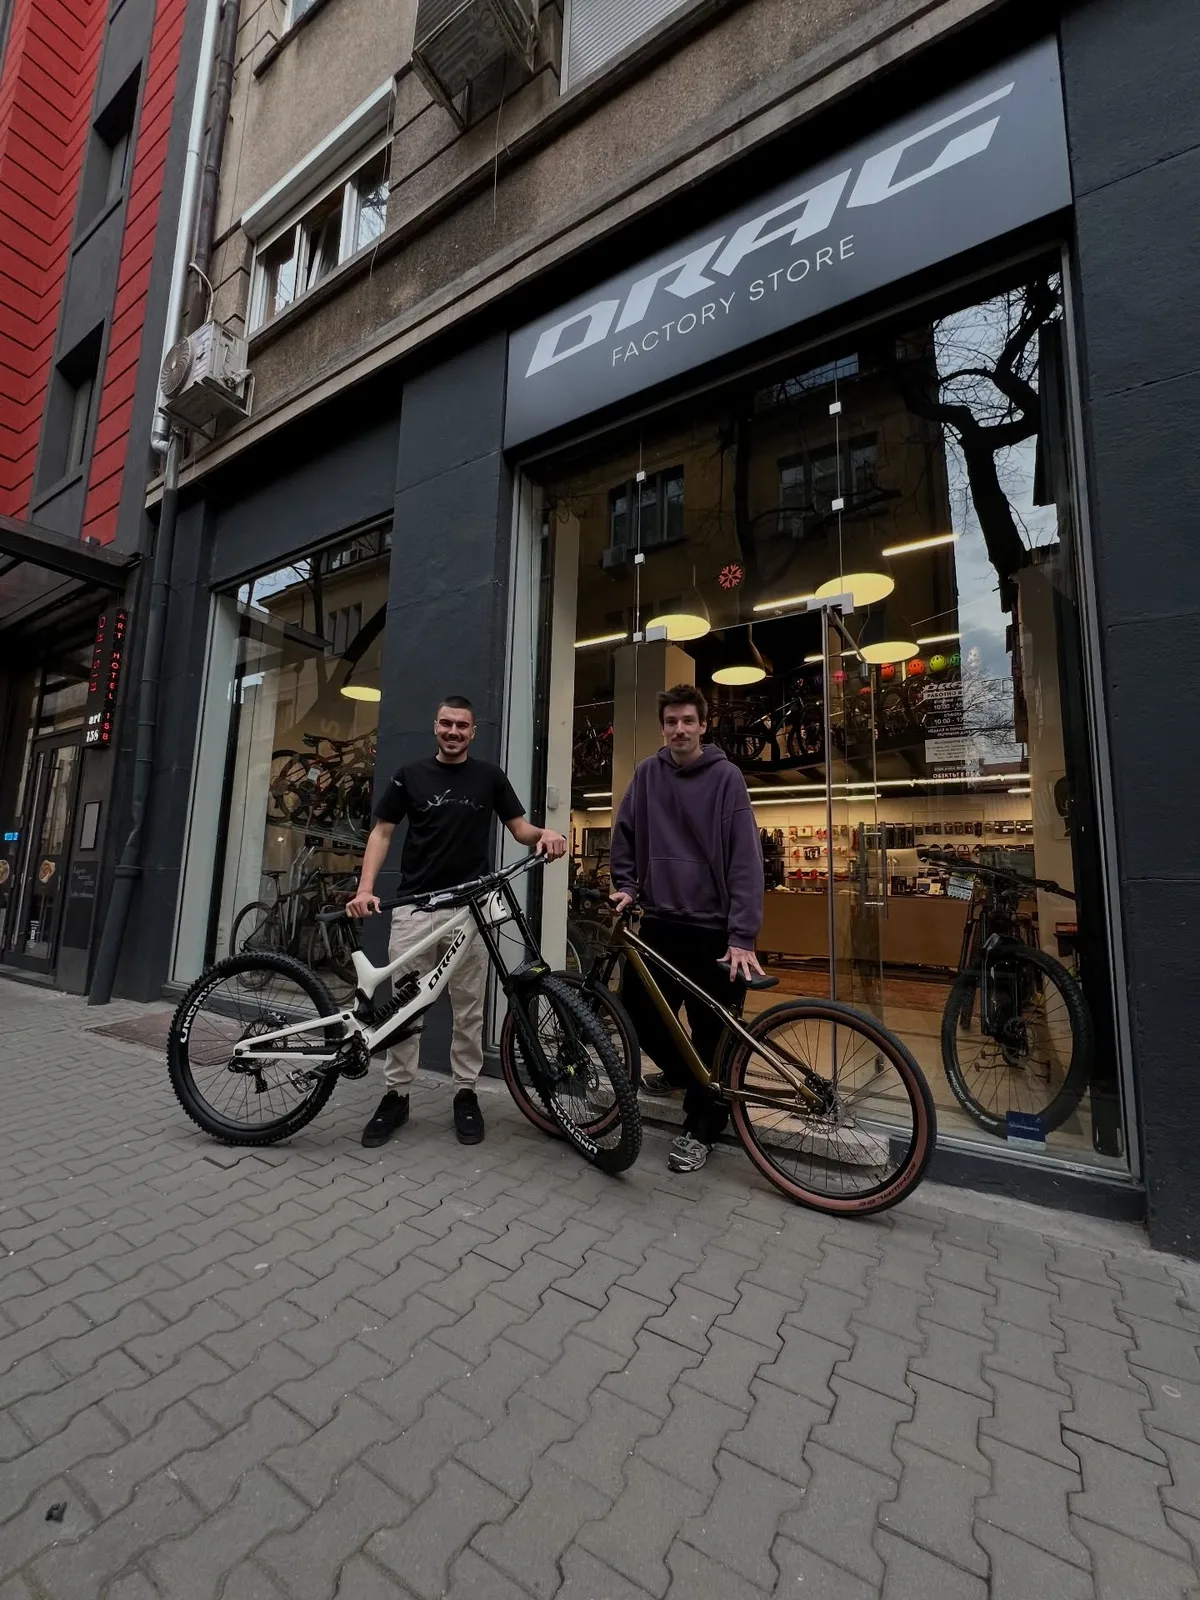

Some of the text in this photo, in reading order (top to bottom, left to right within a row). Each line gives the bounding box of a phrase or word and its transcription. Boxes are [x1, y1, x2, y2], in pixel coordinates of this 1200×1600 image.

[525, 82, 1015, 378] DRAG
[611, 234, 857, 367] FACTORY STORE
[88, 713, 102, 725] art
[102, 613, 125, 741] ART HOTEL 158
[428, 931, 466, 990] DRAG
